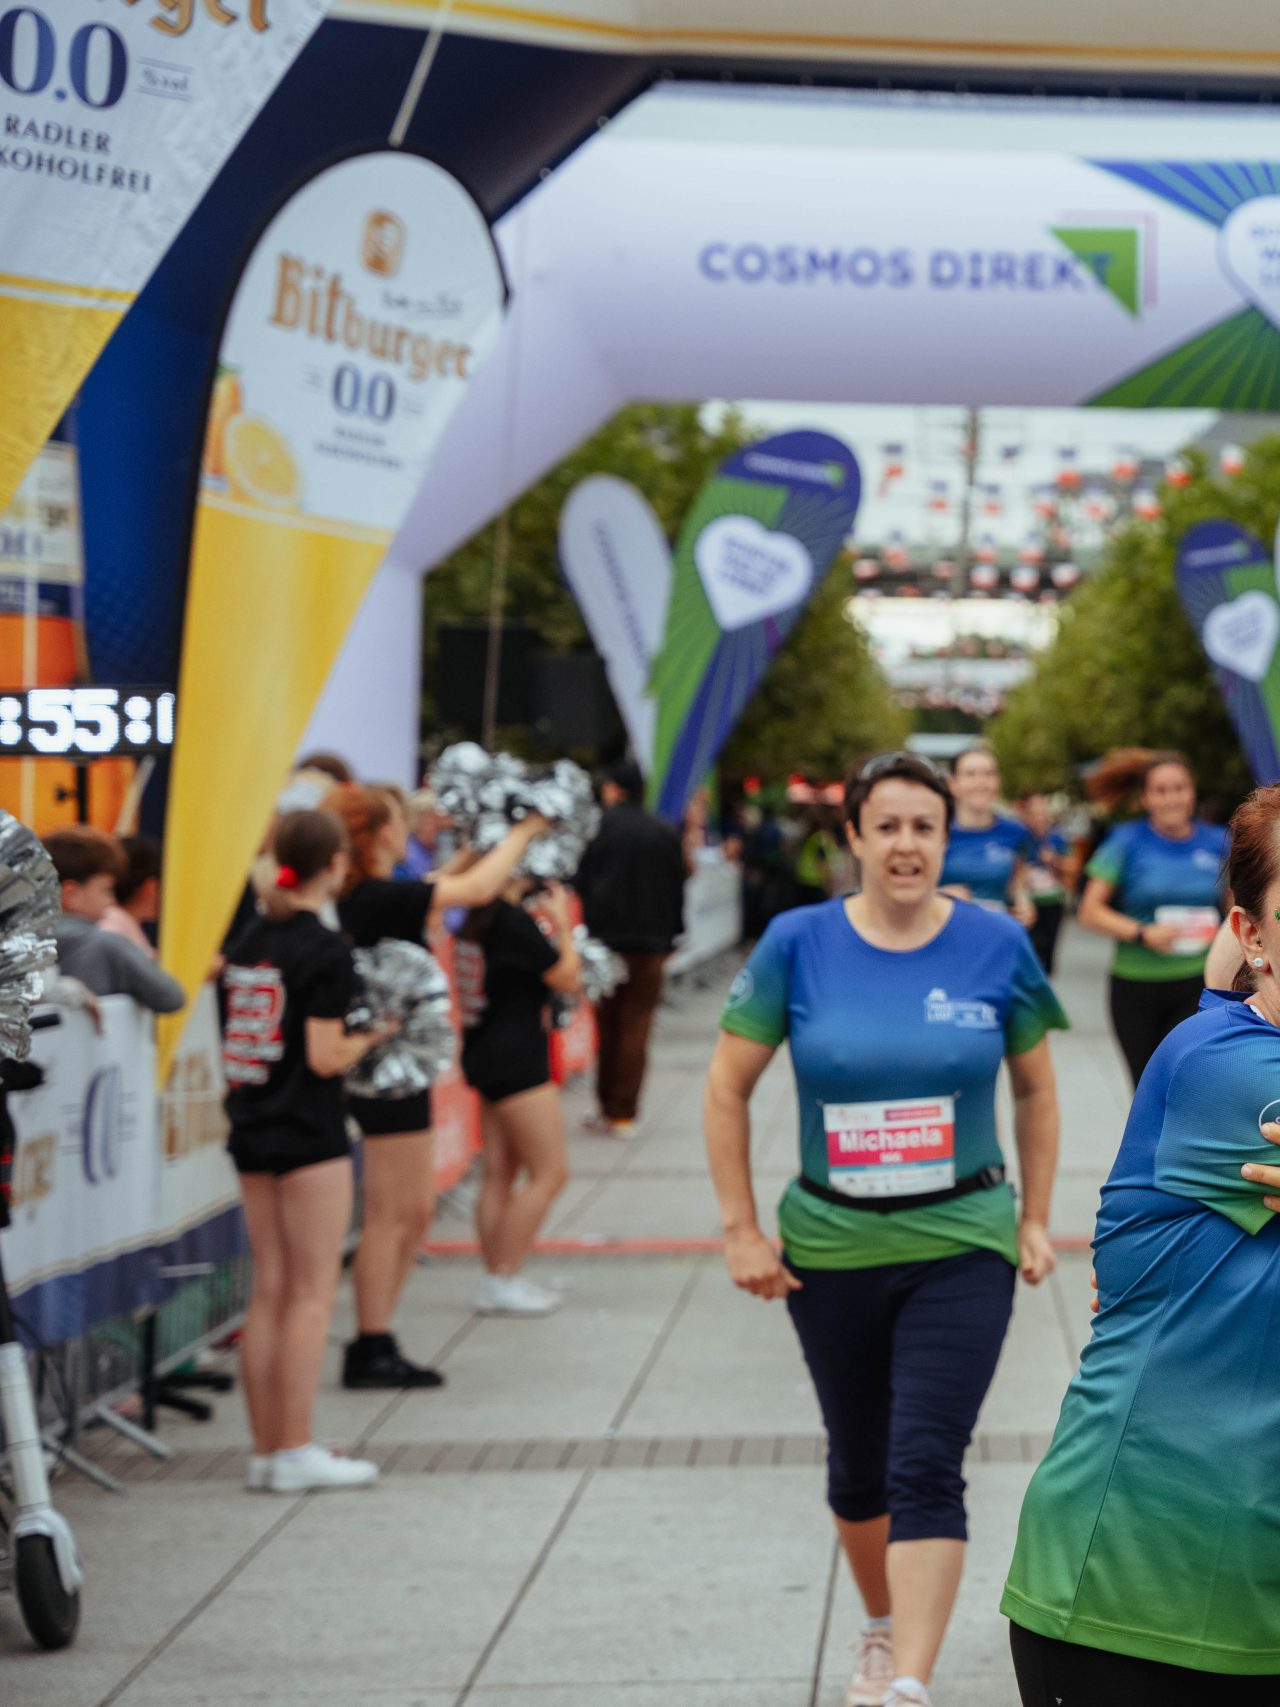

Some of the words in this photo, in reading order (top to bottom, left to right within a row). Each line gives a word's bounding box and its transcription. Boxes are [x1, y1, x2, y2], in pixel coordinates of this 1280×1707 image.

[4, 112, 111, 154] RADLER
[698, 242, 913, 288] COSMOS
[928, 249, 1115, 292] DIREKT
[269, 252, 471, 382] Bitburger
[839, 1125, 943, 1153] Michaela
